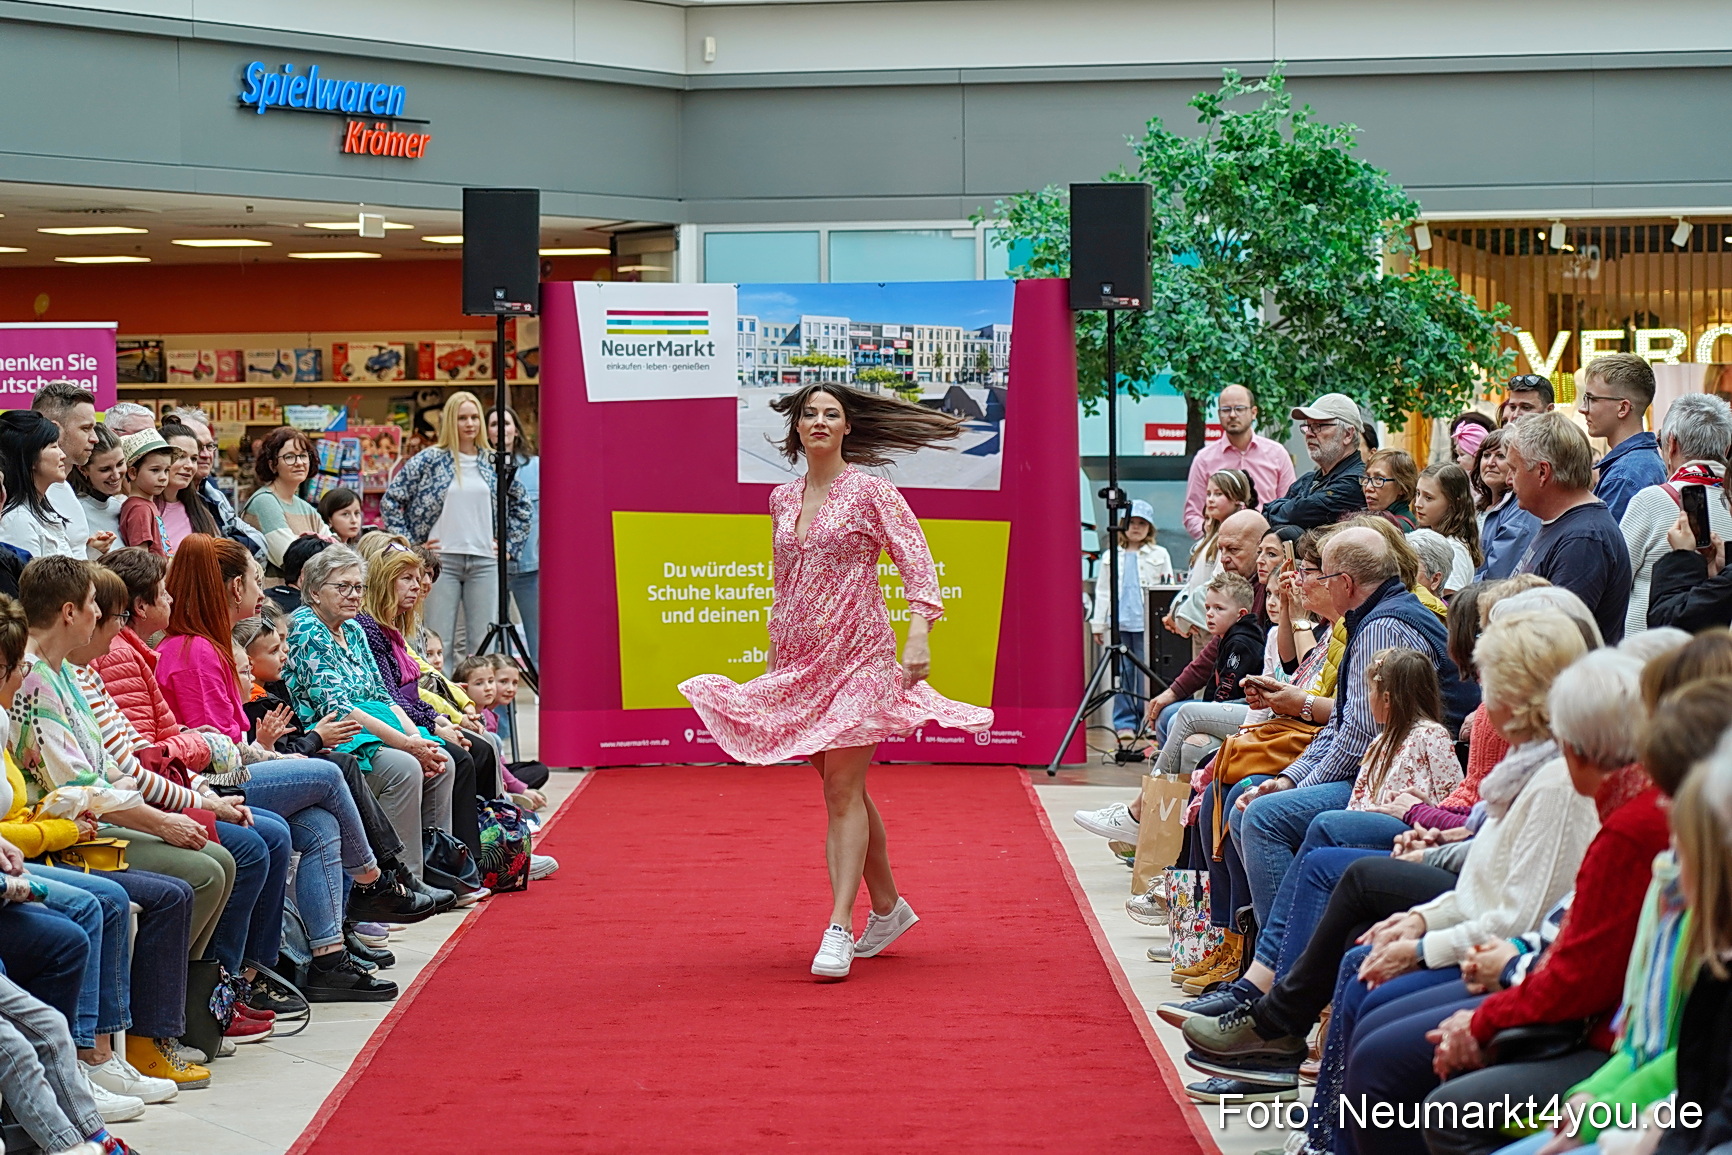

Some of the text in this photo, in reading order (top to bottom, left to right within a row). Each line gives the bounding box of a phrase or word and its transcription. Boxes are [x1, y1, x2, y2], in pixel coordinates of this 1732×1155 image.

[241, 61, 406, 115] Spielwaren
[344, 120, 431, 159] Krömer
[601, 339, 716, 357] NeuerMarkt
[67, 353, 98, 371] Sie
[606, 362, 710, 373] einkaufen leben genießen
[663, 562, 687, 578] Du
[690, 561, 765, 578] würdest
[647, 584, 711, 601] Schuhe
[715, 583, 776, 600] kaufen
[661, 606, 695, 623] und
[698, 606, 760, 623] deinen
